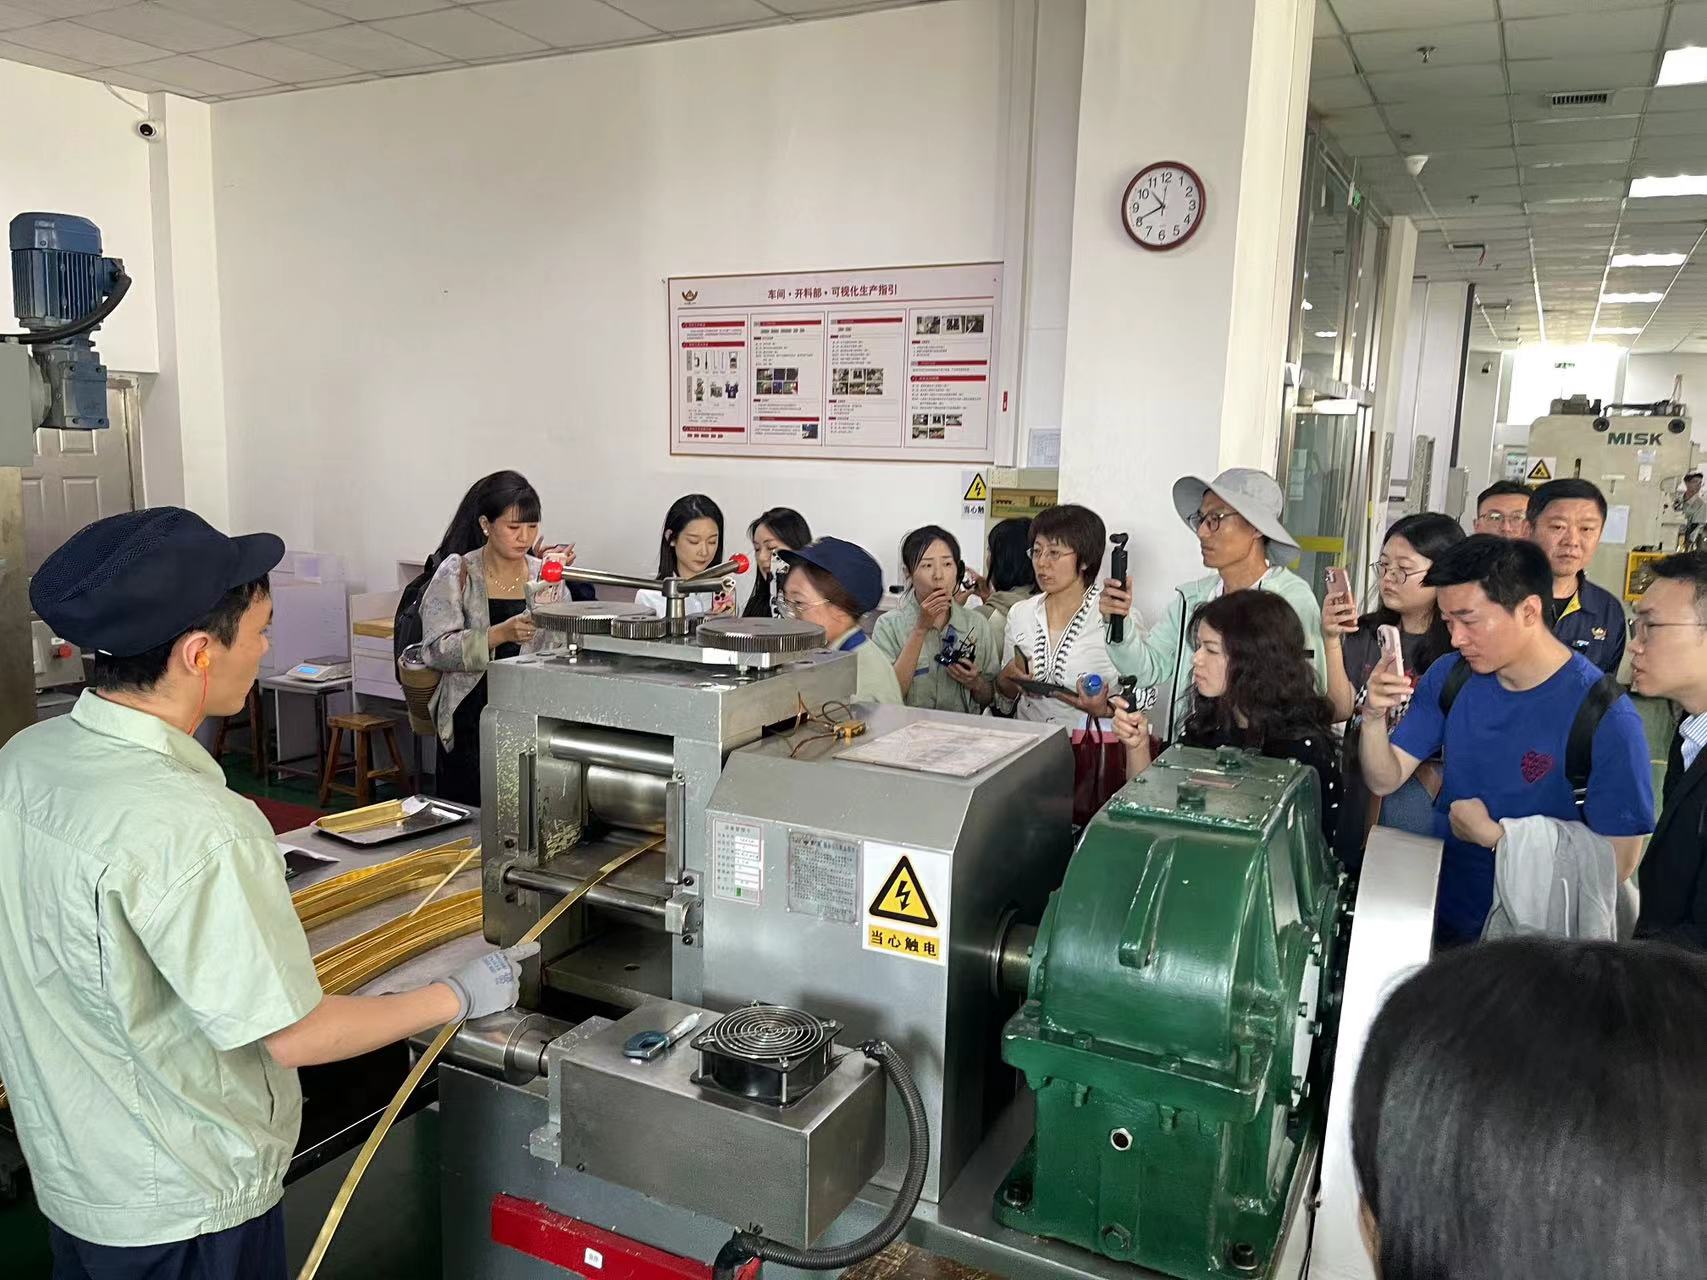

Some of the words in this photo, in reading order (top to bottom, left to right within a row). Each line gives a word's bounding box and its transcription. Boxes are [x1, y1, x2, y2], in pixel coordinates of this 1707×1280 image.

[1148, 176, 1157, 188] 11
[1160, 171, 1173, 184] 12
[1137, 188, 1150, 200] 10
[1185, 186, 1193, 198] 2
[1132, 202, 1140, 213] 9
[1188, 200, 1196, 211] 3
[1135, 216, 1143, 227] 8
[1183, 214, 1191, 225] 4
[1145, 225, 1153, 237] 7
[1158, 229, 1166, 241] 6
[1172, 224, 1180, 236] 5
[1607, 432, 1664, 446] MISK
[871, 930, 937, 957] 当心触电
